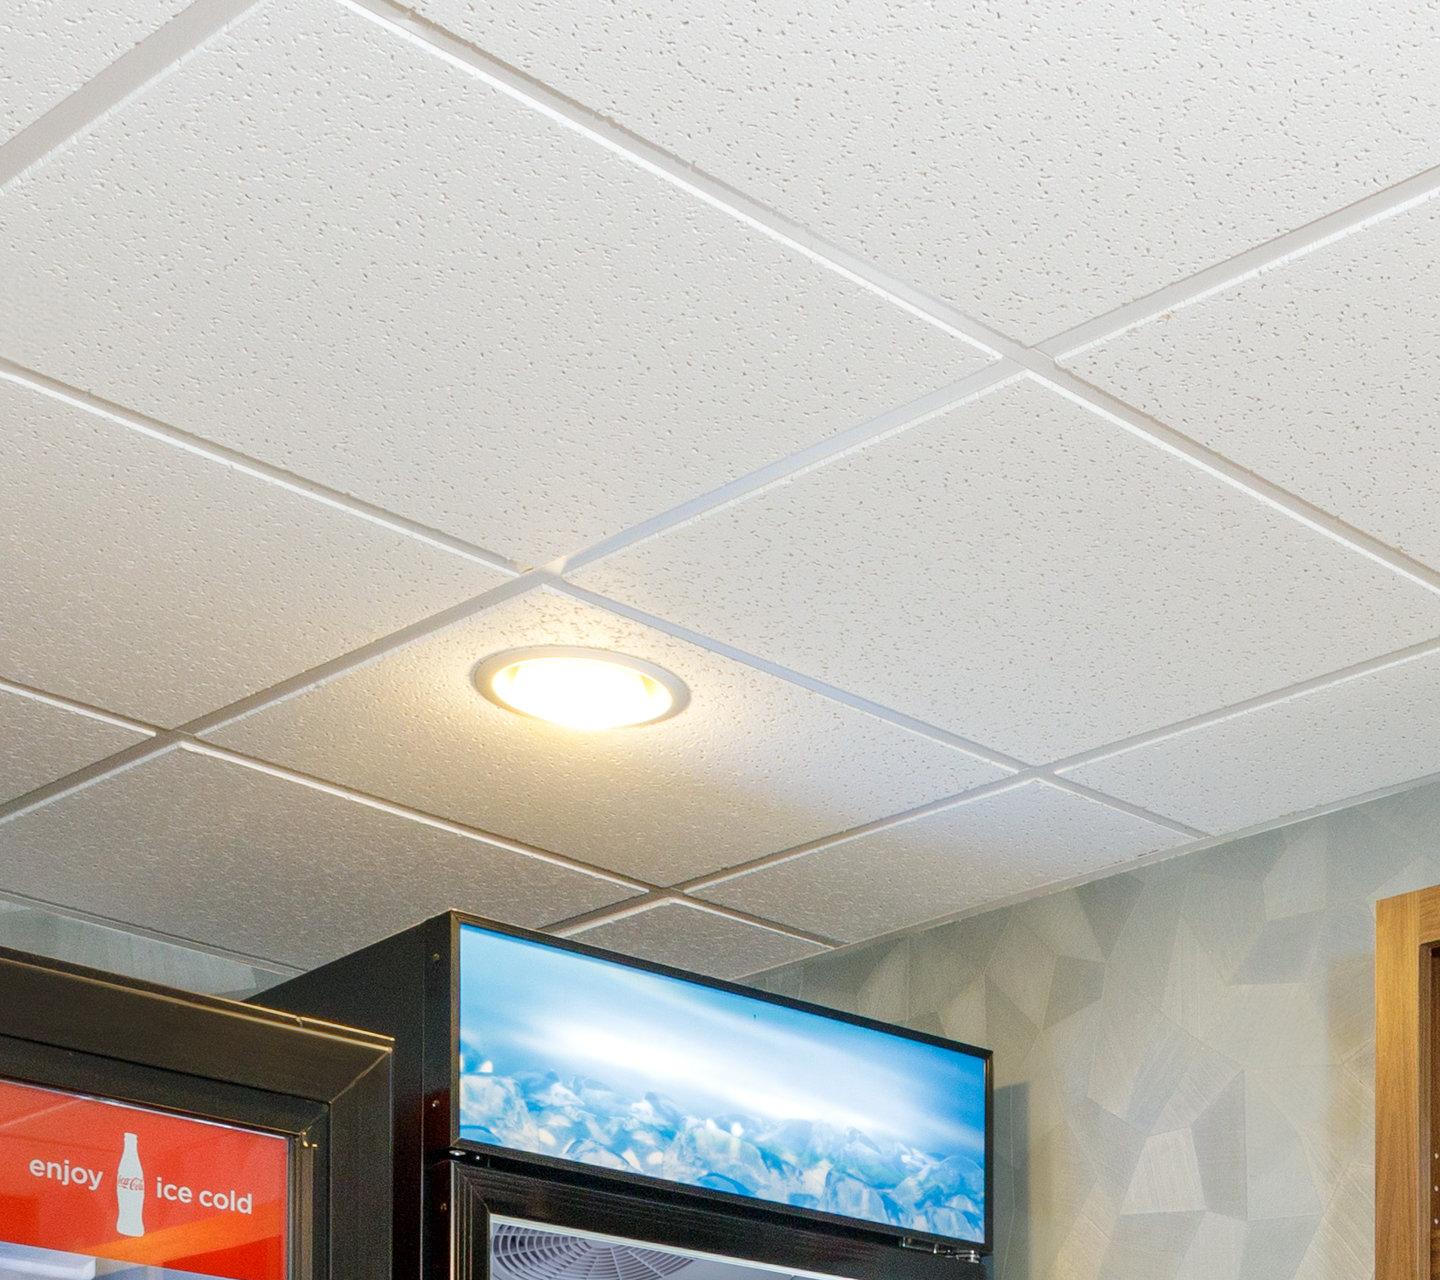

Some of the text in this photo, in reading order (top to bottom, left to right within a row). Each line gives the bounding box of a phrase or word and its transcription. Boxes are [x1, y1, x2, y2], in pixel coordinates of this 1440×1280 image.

[29, 1155, 253, 1216] enjoy ice cold
